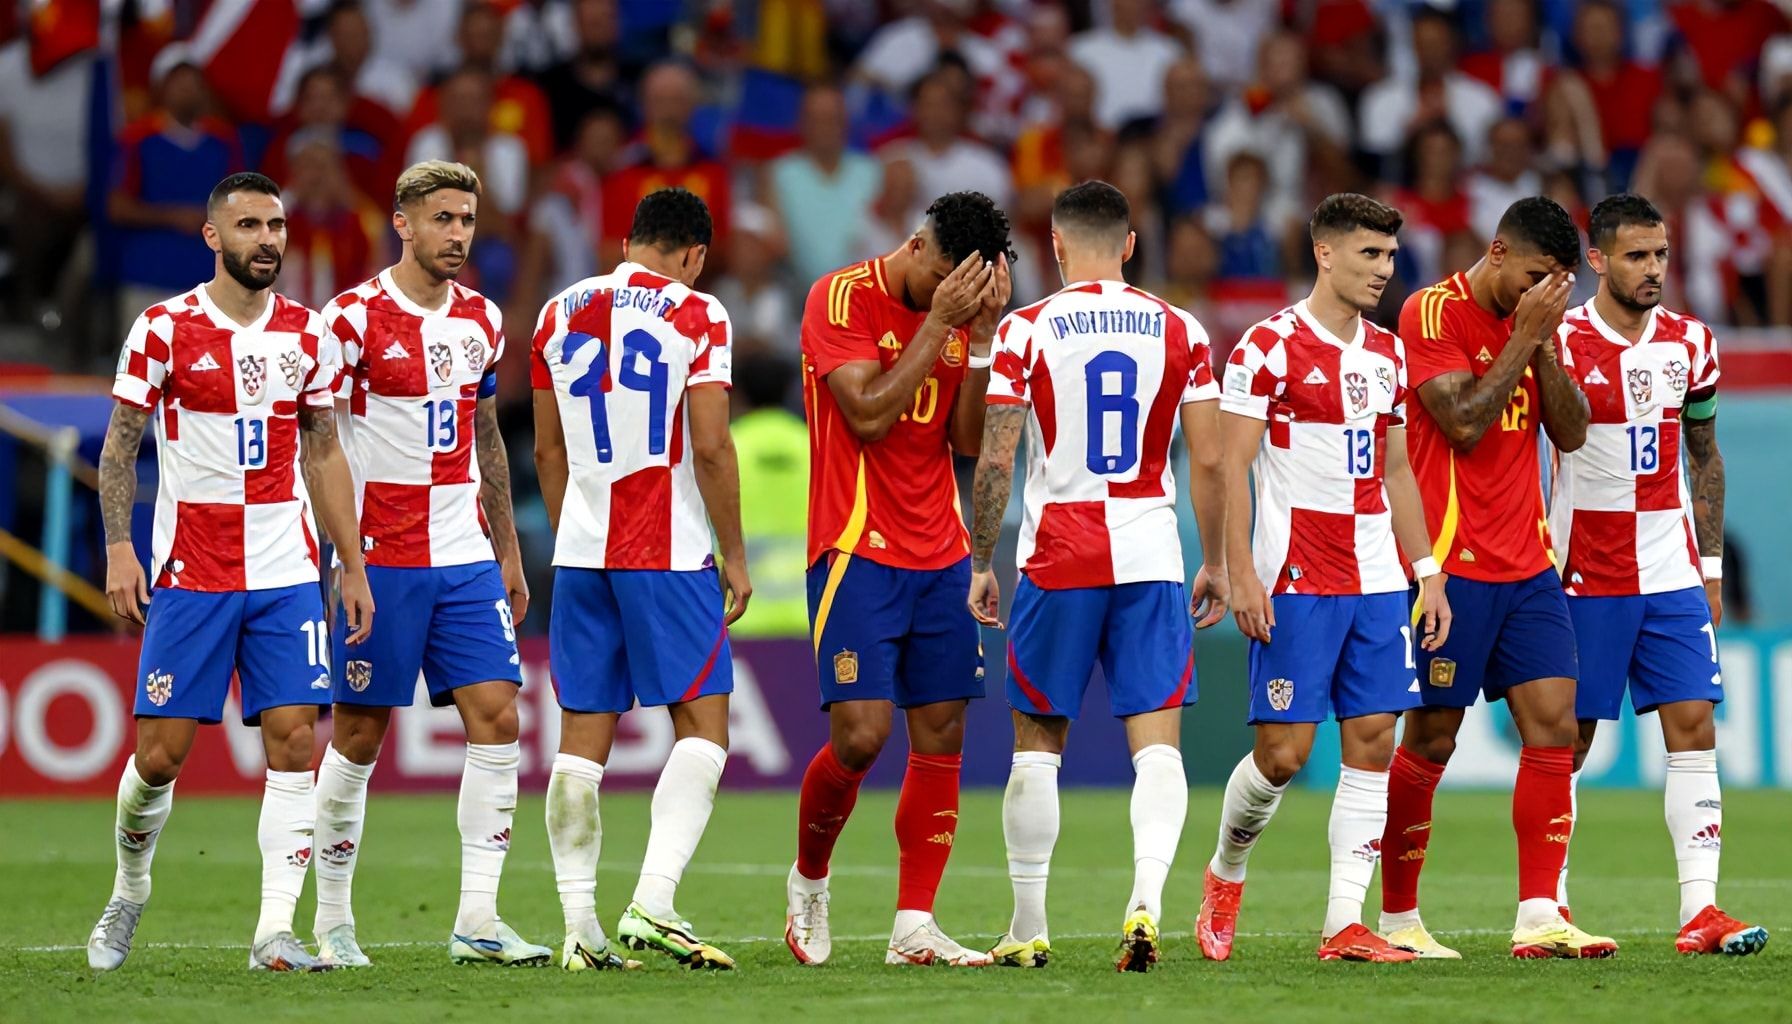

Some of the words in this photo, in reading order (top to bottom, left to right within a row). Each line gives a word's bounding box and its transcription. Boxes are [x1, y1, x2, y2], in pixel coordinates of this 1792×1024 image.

[422, 400, 455, 447] 13
[900, 376, 938, 424] 0
[1085, 350, 1139, 475] 8
[234, 417, 264, 466] 13
[1343, 429, 1371, 474] 13
[1626, 425, 1656, 471] 13
